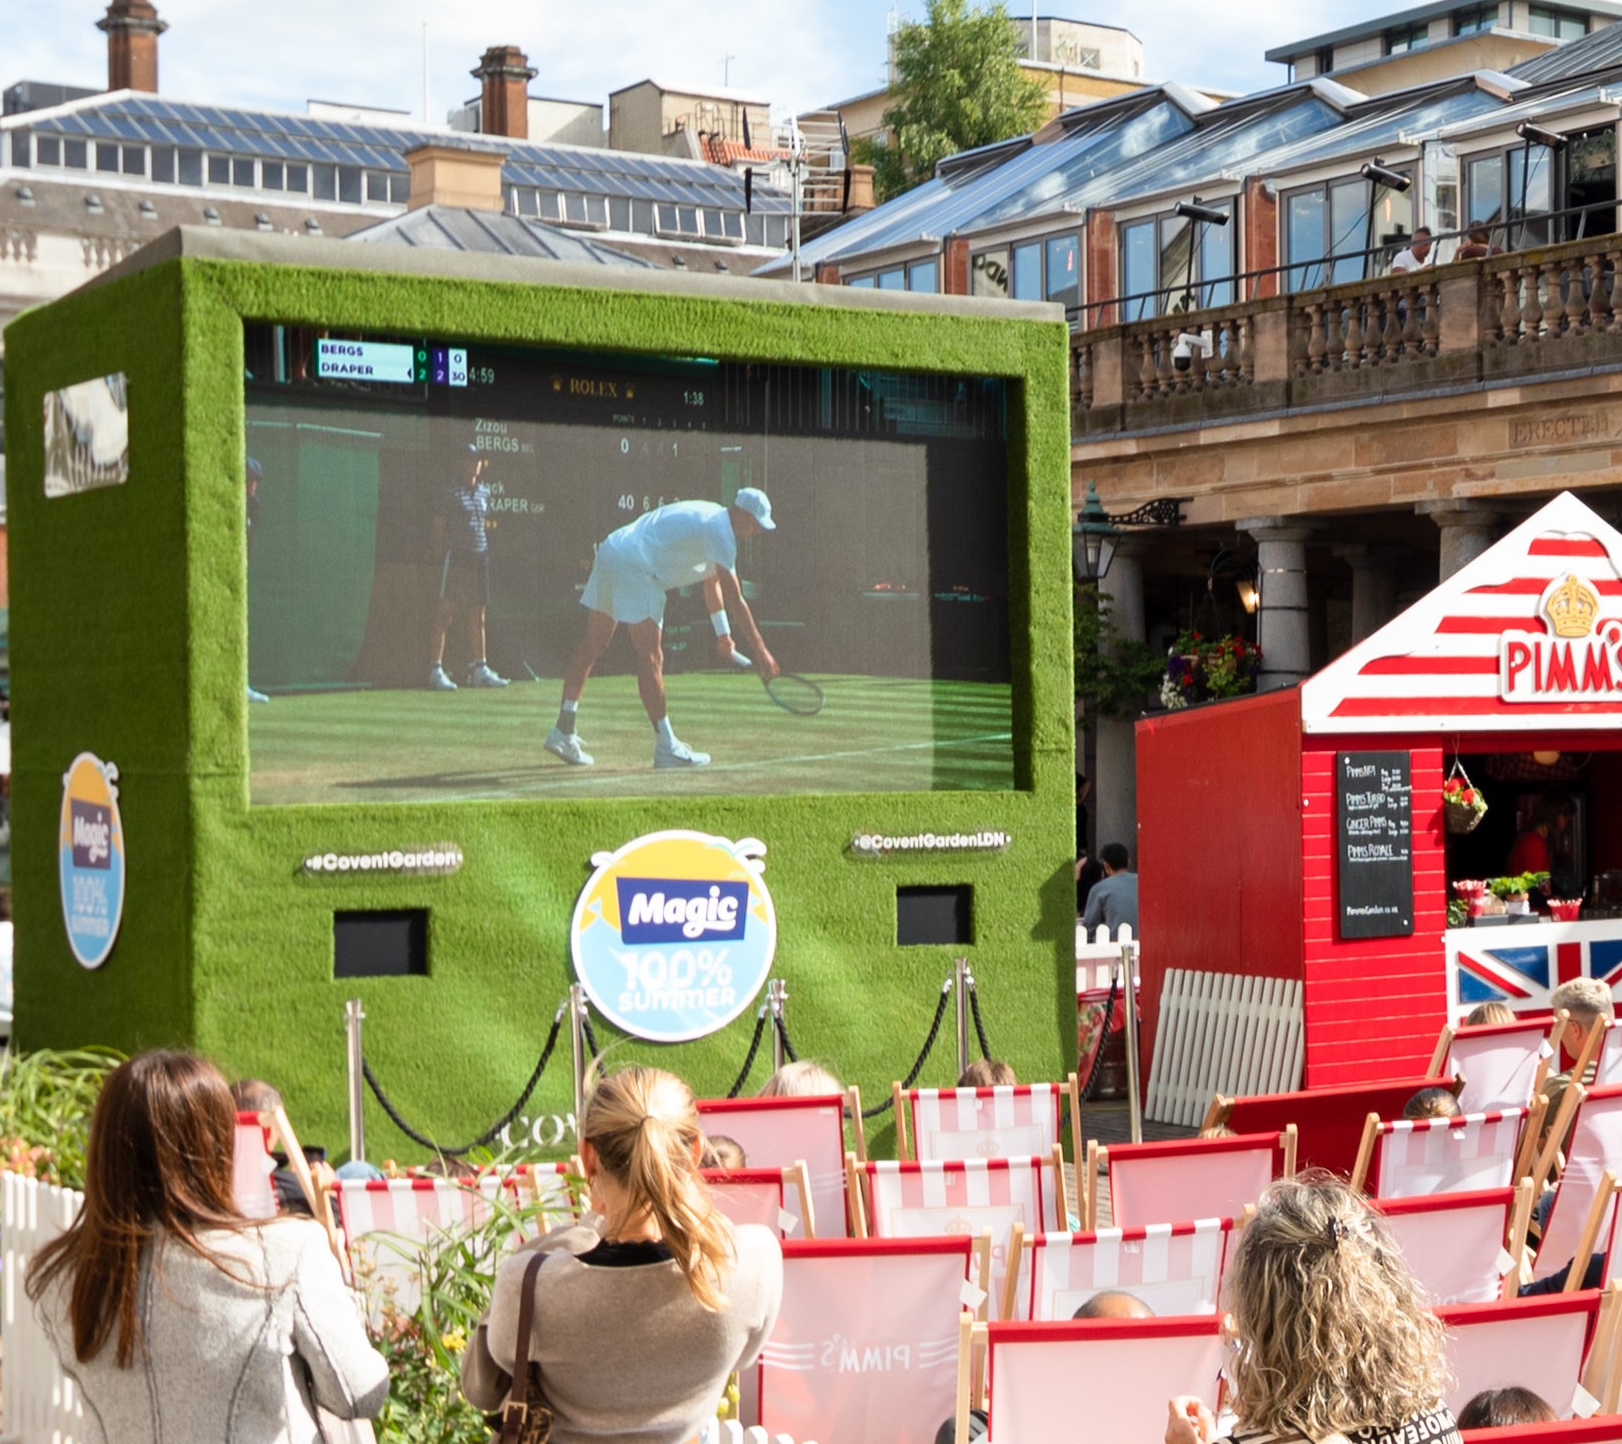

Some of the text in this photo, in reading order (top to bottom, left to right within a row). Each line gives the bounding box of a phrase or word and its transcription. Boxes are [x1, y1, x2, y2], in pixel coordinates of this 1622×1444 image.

[321, 344, 364, 357] BERGS
[321, 362, 374, 375] DRAPER
[451, 370, 466, 382] 30
[569, 378, 618, 397] ROLEX
[683, 390, 704, 406] 1:38
[475, 418, 507, 434] Zizou
[476, 435, 519, 453] BERGS
[620, 438, 629, 454] 0
[488, 498, 529, 514] RAPER
[618, 494, 634, 511] 40
[73, 811, 109, 863] Magic
[859, 832, 1005, 850] @CoventGardenLDN
[312, 850, 456, 871] #CoventGarden
[628, 885, 739, 939] Magic
[618, 947, 734, 991] 100%
